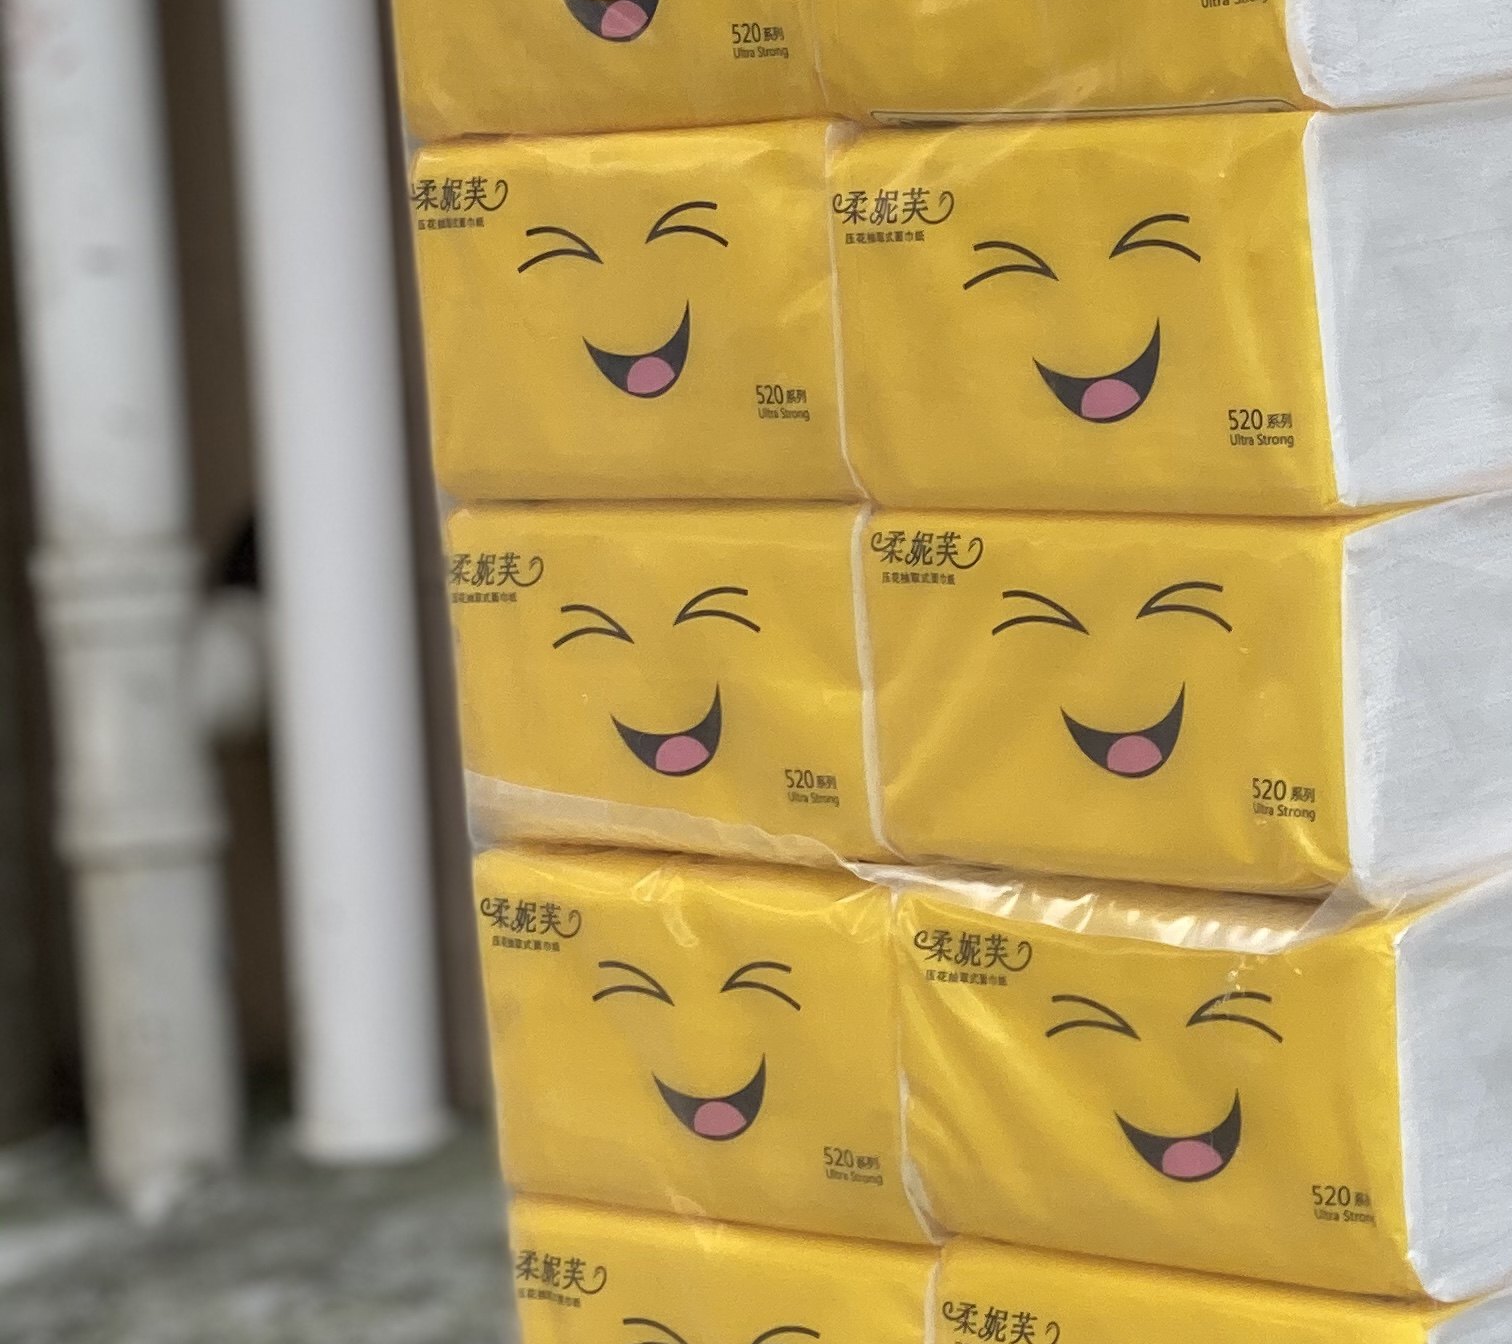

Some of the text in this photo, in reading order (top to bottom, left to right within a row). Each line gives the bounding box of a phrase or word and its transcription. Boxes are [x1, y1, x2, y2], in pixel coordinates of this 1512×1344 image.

[733, 47, 789, 59] Ultra Strong
[411, 176, 508, 212] 柔妮芙
[832, 187, 954, 225] 柔妮芙
[758, 407, 810, 422] Ultra Strong
[1230, 434, 1294, 448] Ultra Strong
[871, 530, 983, 570] 柔妮芙
[788, 791, 839, 807] Ultra Strong
[1253, 802, 1316, 822] Ultra Strong
[480, 897, 582, 939] 柔妮芙
[914, 929, 1032, 972] 柔妮芙
[826, 1168, 883, 1186] Ultra Strong
[1313, 1208, 1339, 1222] Ultra
